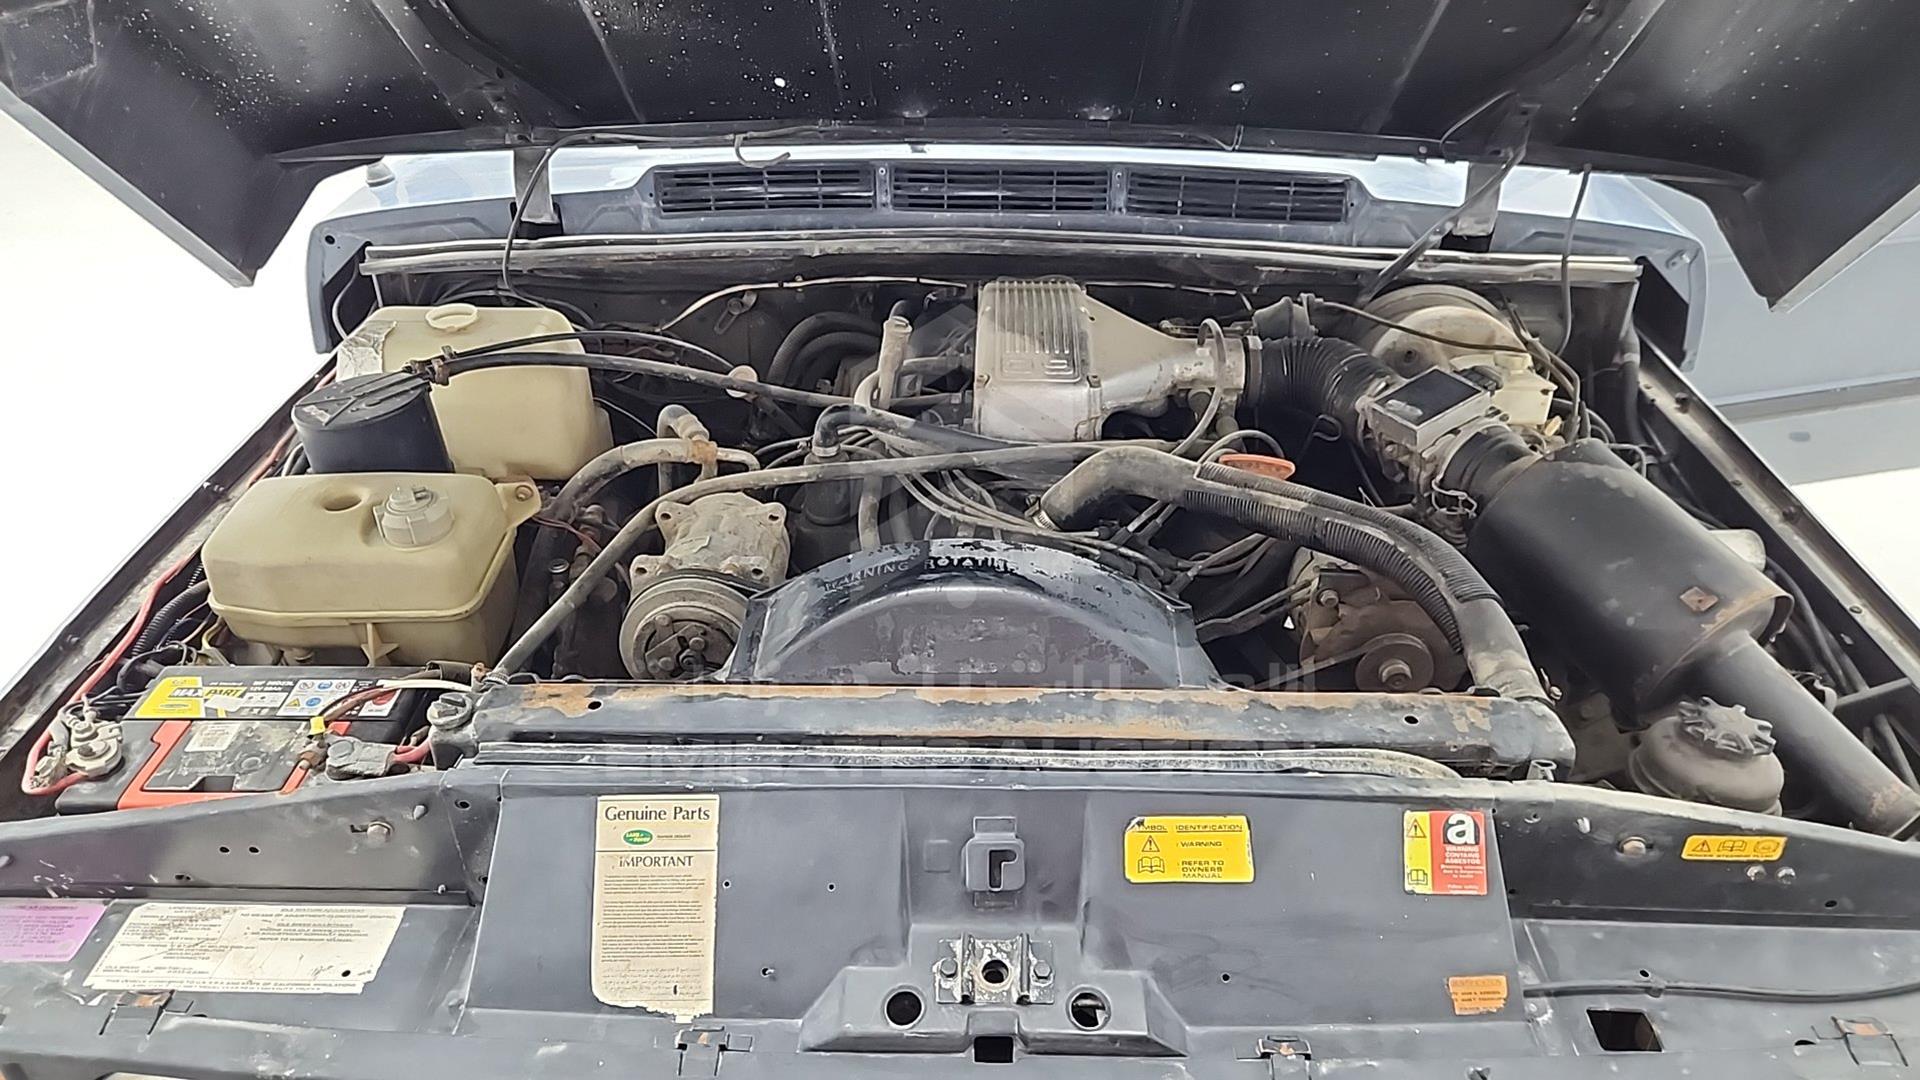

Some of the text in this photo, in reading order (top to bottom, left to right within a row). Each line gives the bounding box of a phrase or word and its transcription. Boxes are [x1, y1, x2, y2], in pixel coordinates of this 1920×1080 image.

[204, 688, 241, 698] PART
[605, 805, 710, 821] Genuine Parts
[619, 855, 694, 868] IMPORTANT
